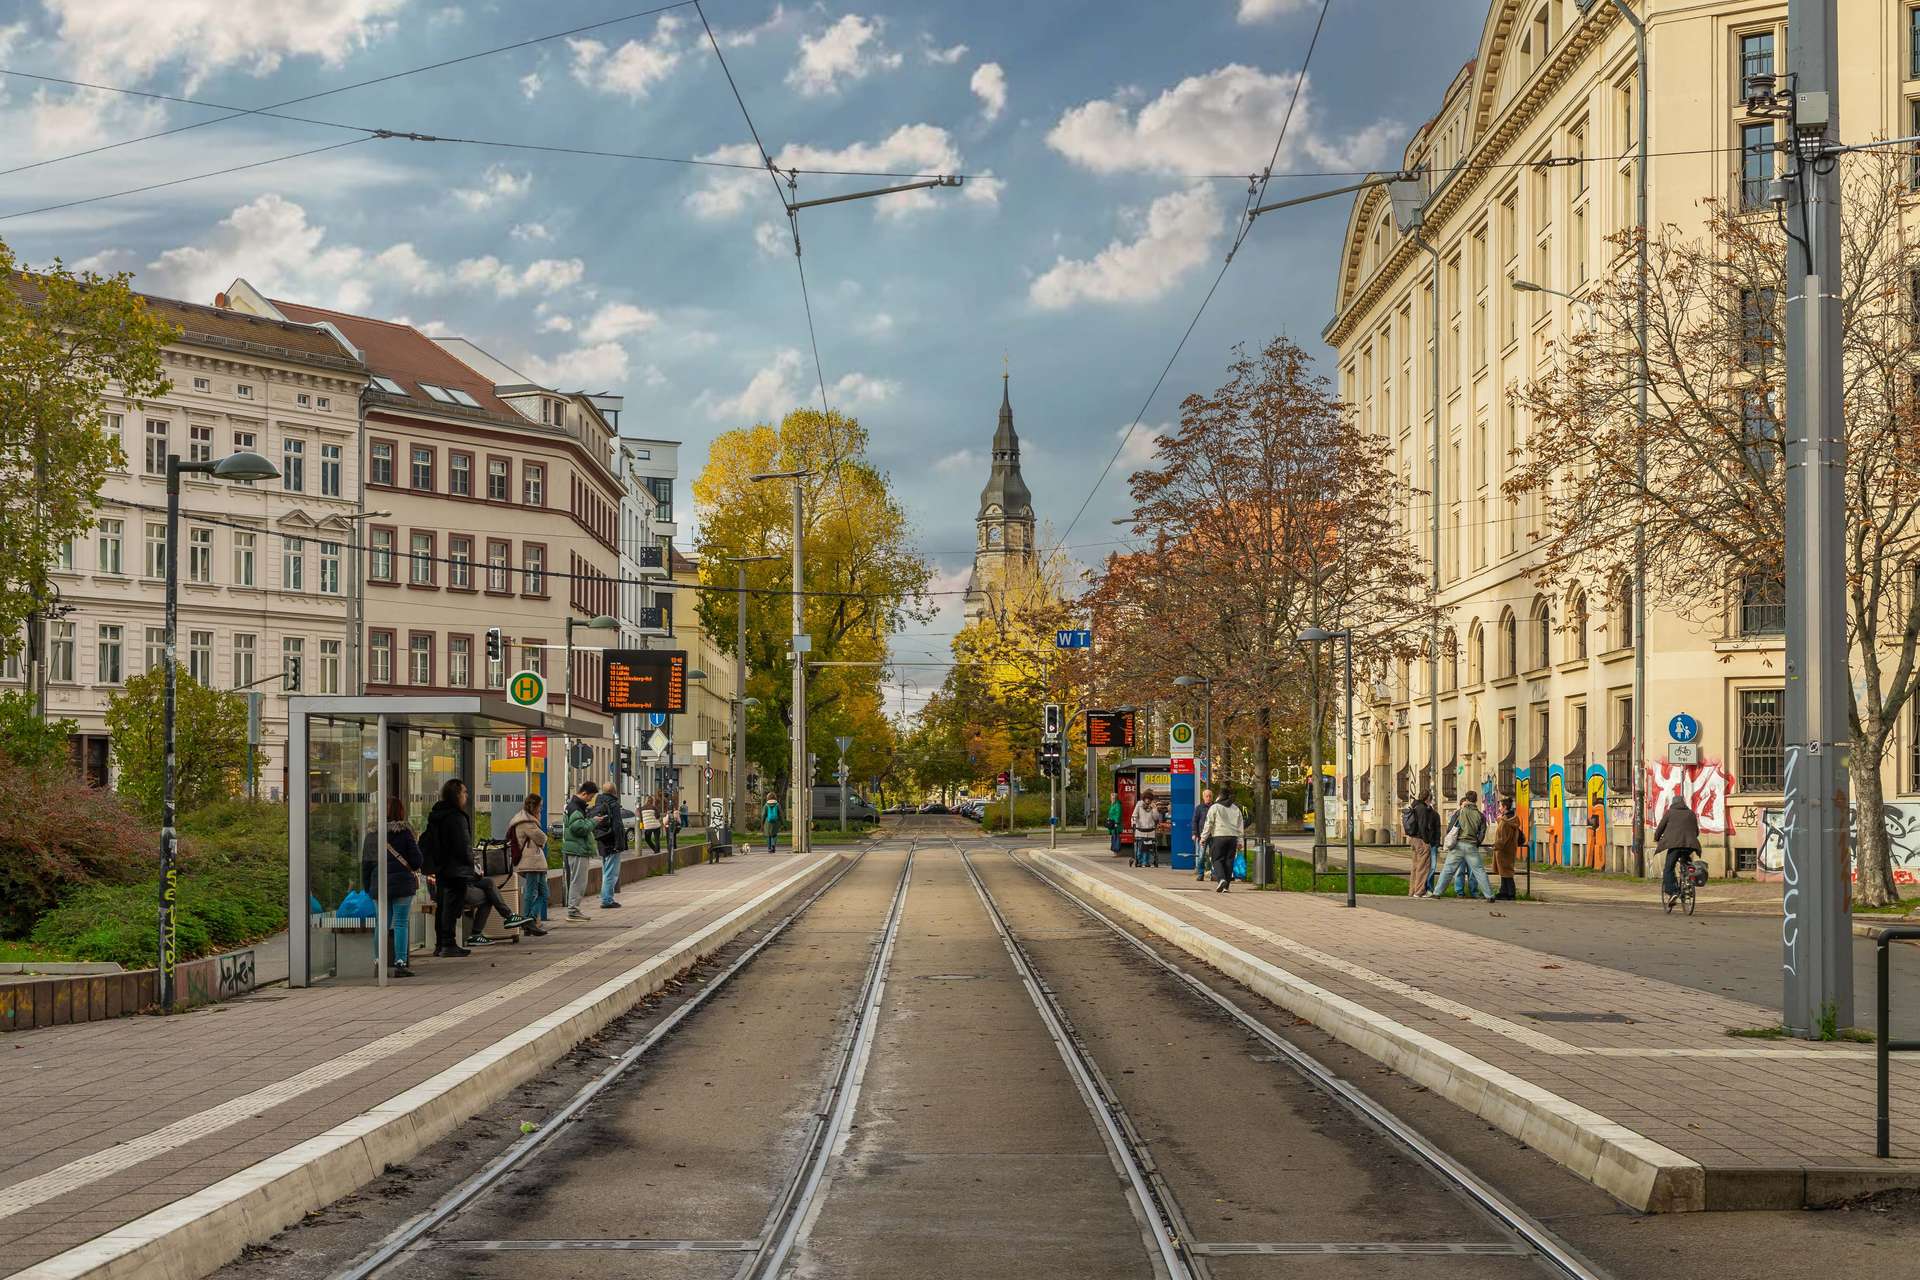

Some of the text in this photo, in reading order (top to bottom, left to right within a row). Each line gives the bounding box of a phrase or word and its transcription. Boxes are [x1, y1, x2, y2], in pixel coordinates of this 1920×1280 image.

[1059, 632, 1087, 646] W T
[520, 680, 534, 698] H
[1178, 726, 1187, 739] H
[510, 741, 518, 749] 11
[510, 749, 519, 757] 16
